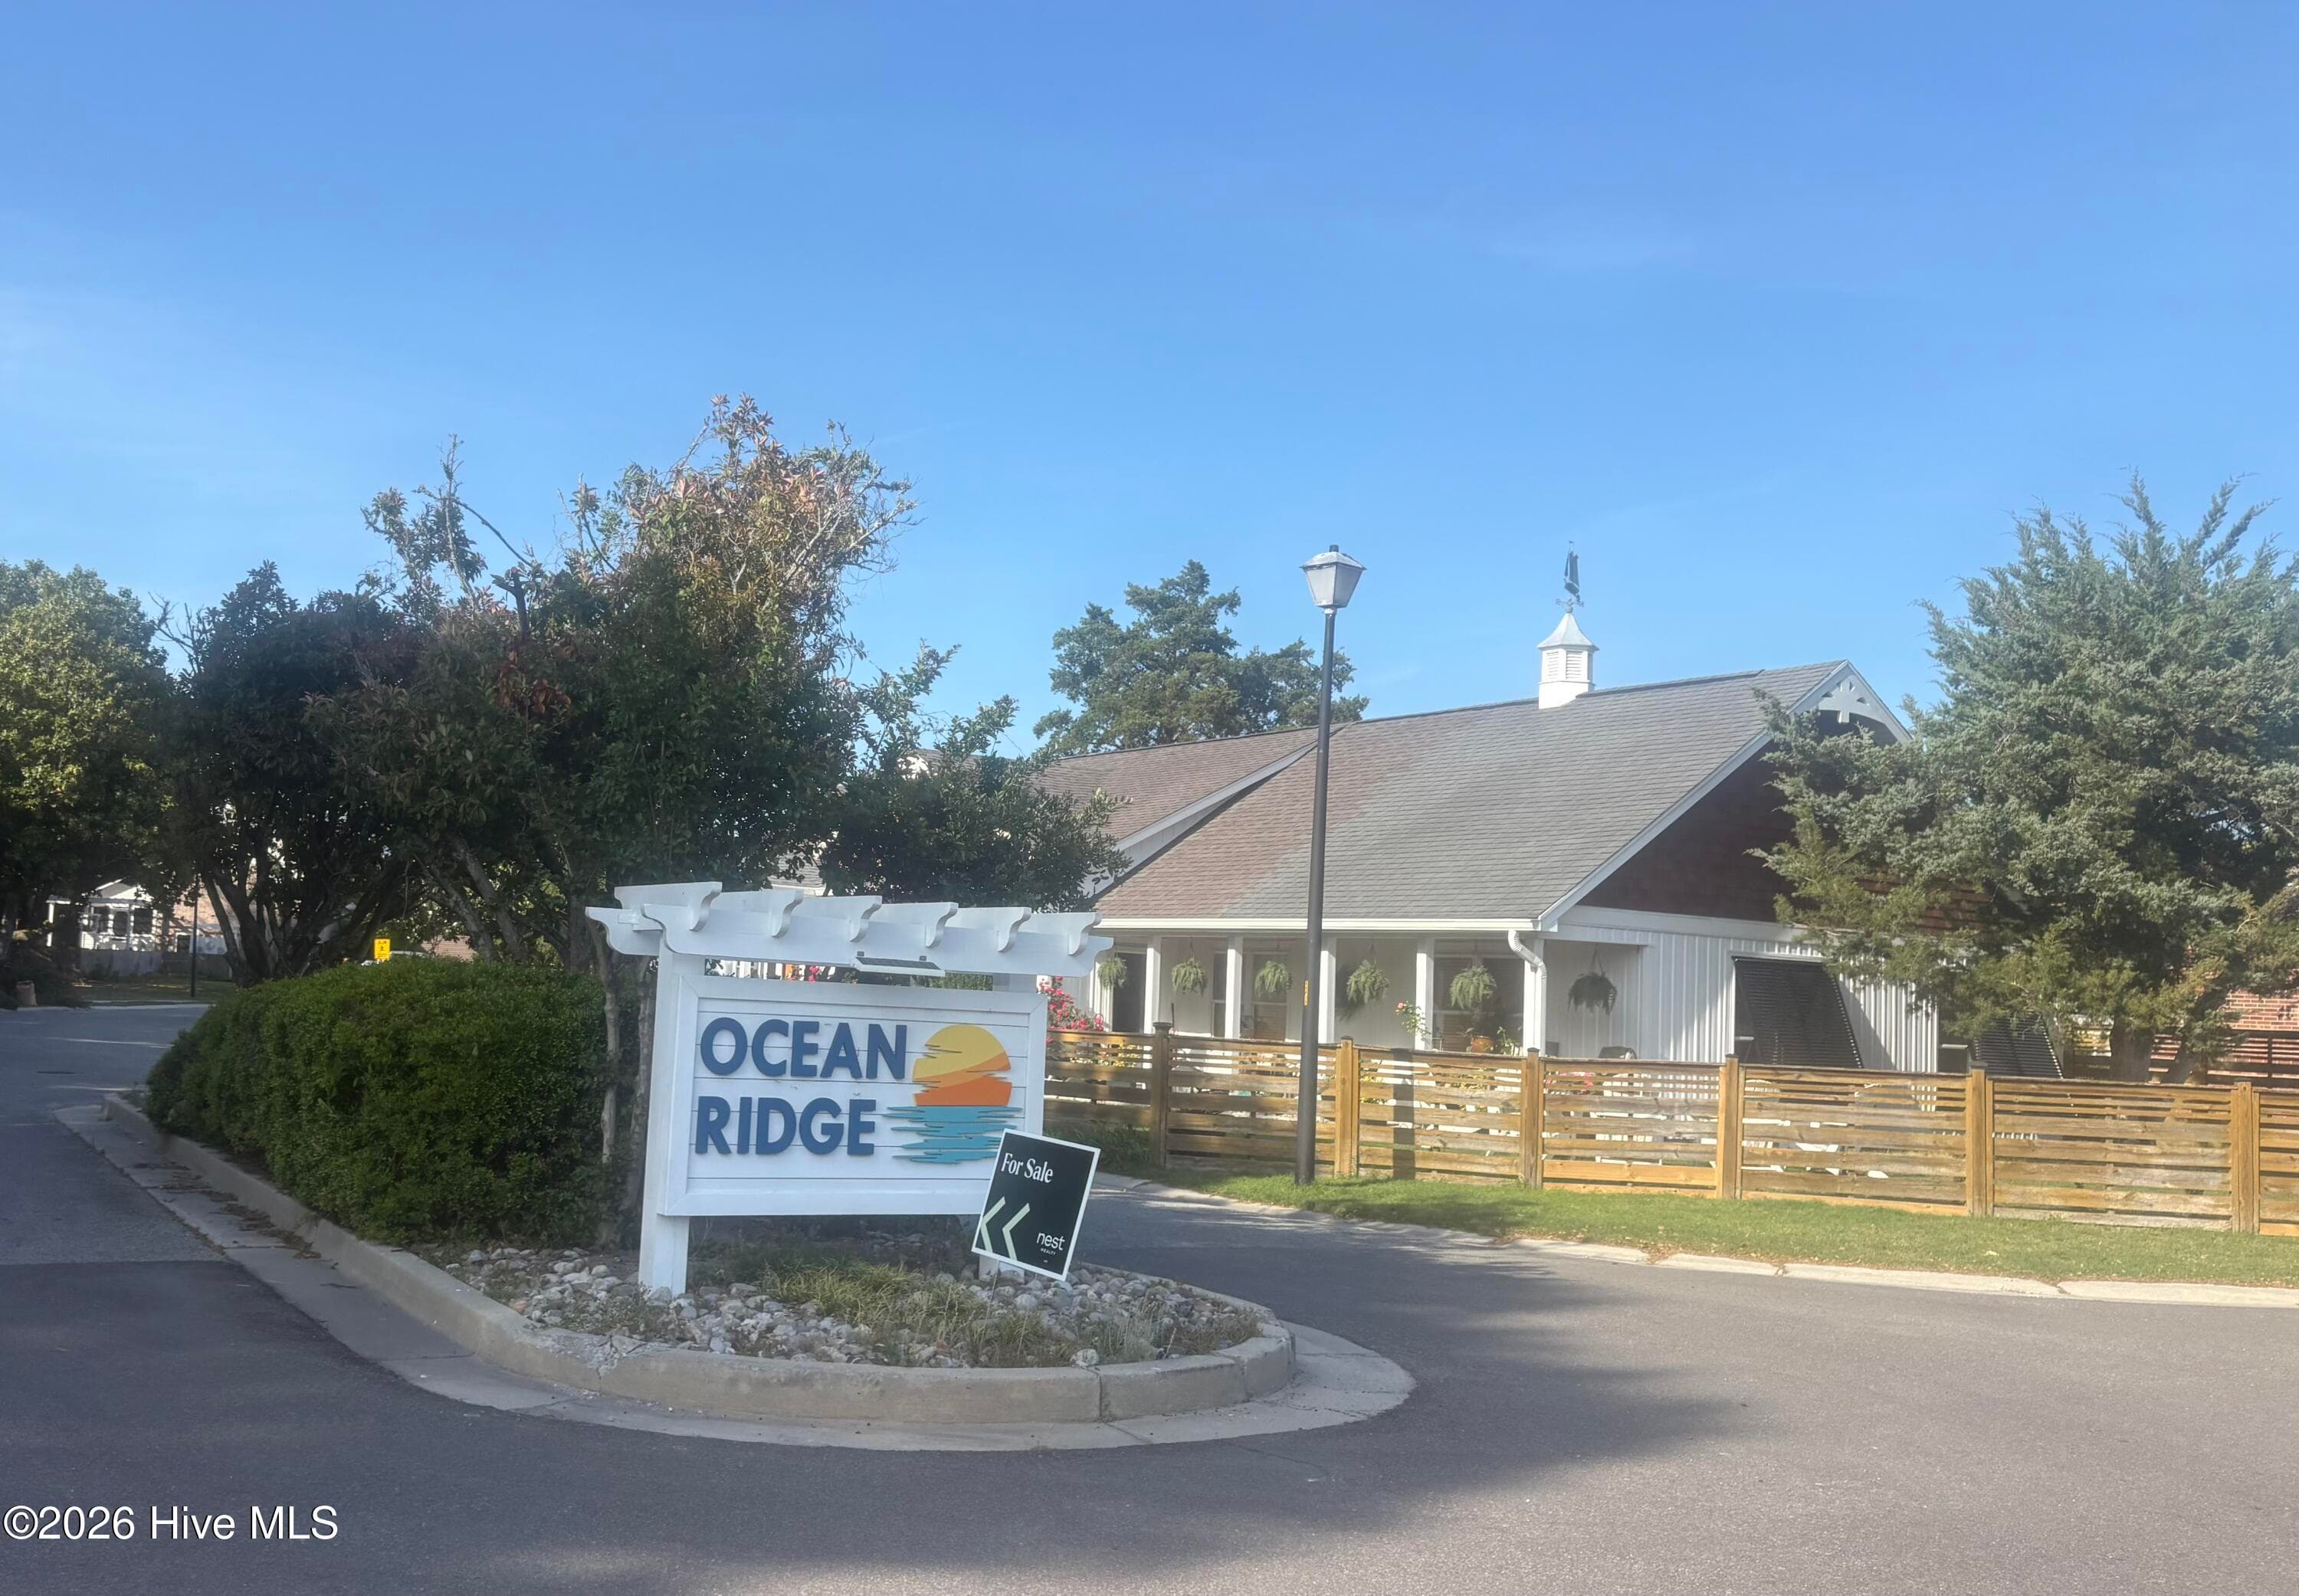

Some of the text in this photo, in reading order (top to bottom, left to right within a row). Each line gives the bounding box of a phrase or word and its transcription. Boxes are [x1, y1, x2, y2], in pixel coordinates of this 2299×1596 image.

[700, 1018, 907, 1080] OCEAN
[695, 1096, 877, 1156] RIDGE
[1001, 1152, 1054, 1184] For Sale
[1036, 1232, 1065, 1251] nest
